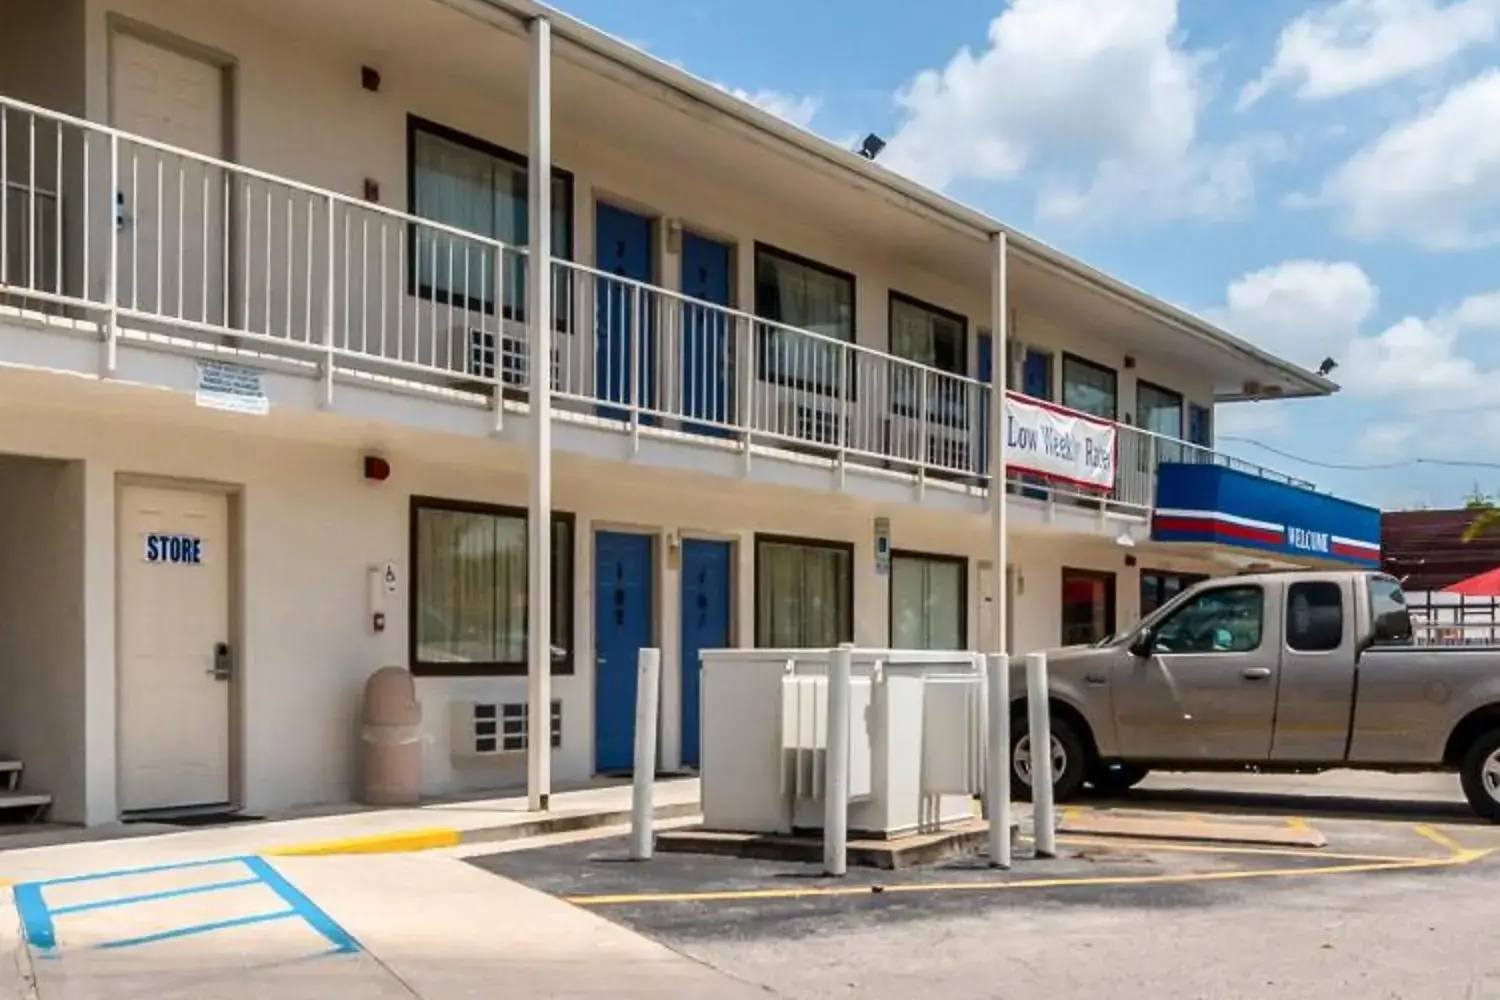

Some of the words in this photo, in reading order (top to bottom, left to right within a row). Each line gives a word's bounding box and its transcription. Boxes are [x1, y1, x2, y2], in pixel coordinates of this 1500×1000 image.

[1007, 415, 1038, 451] Low
[147, 535, 201, 563] STORE
[1287, 526, 1329, 552] WELCOME
